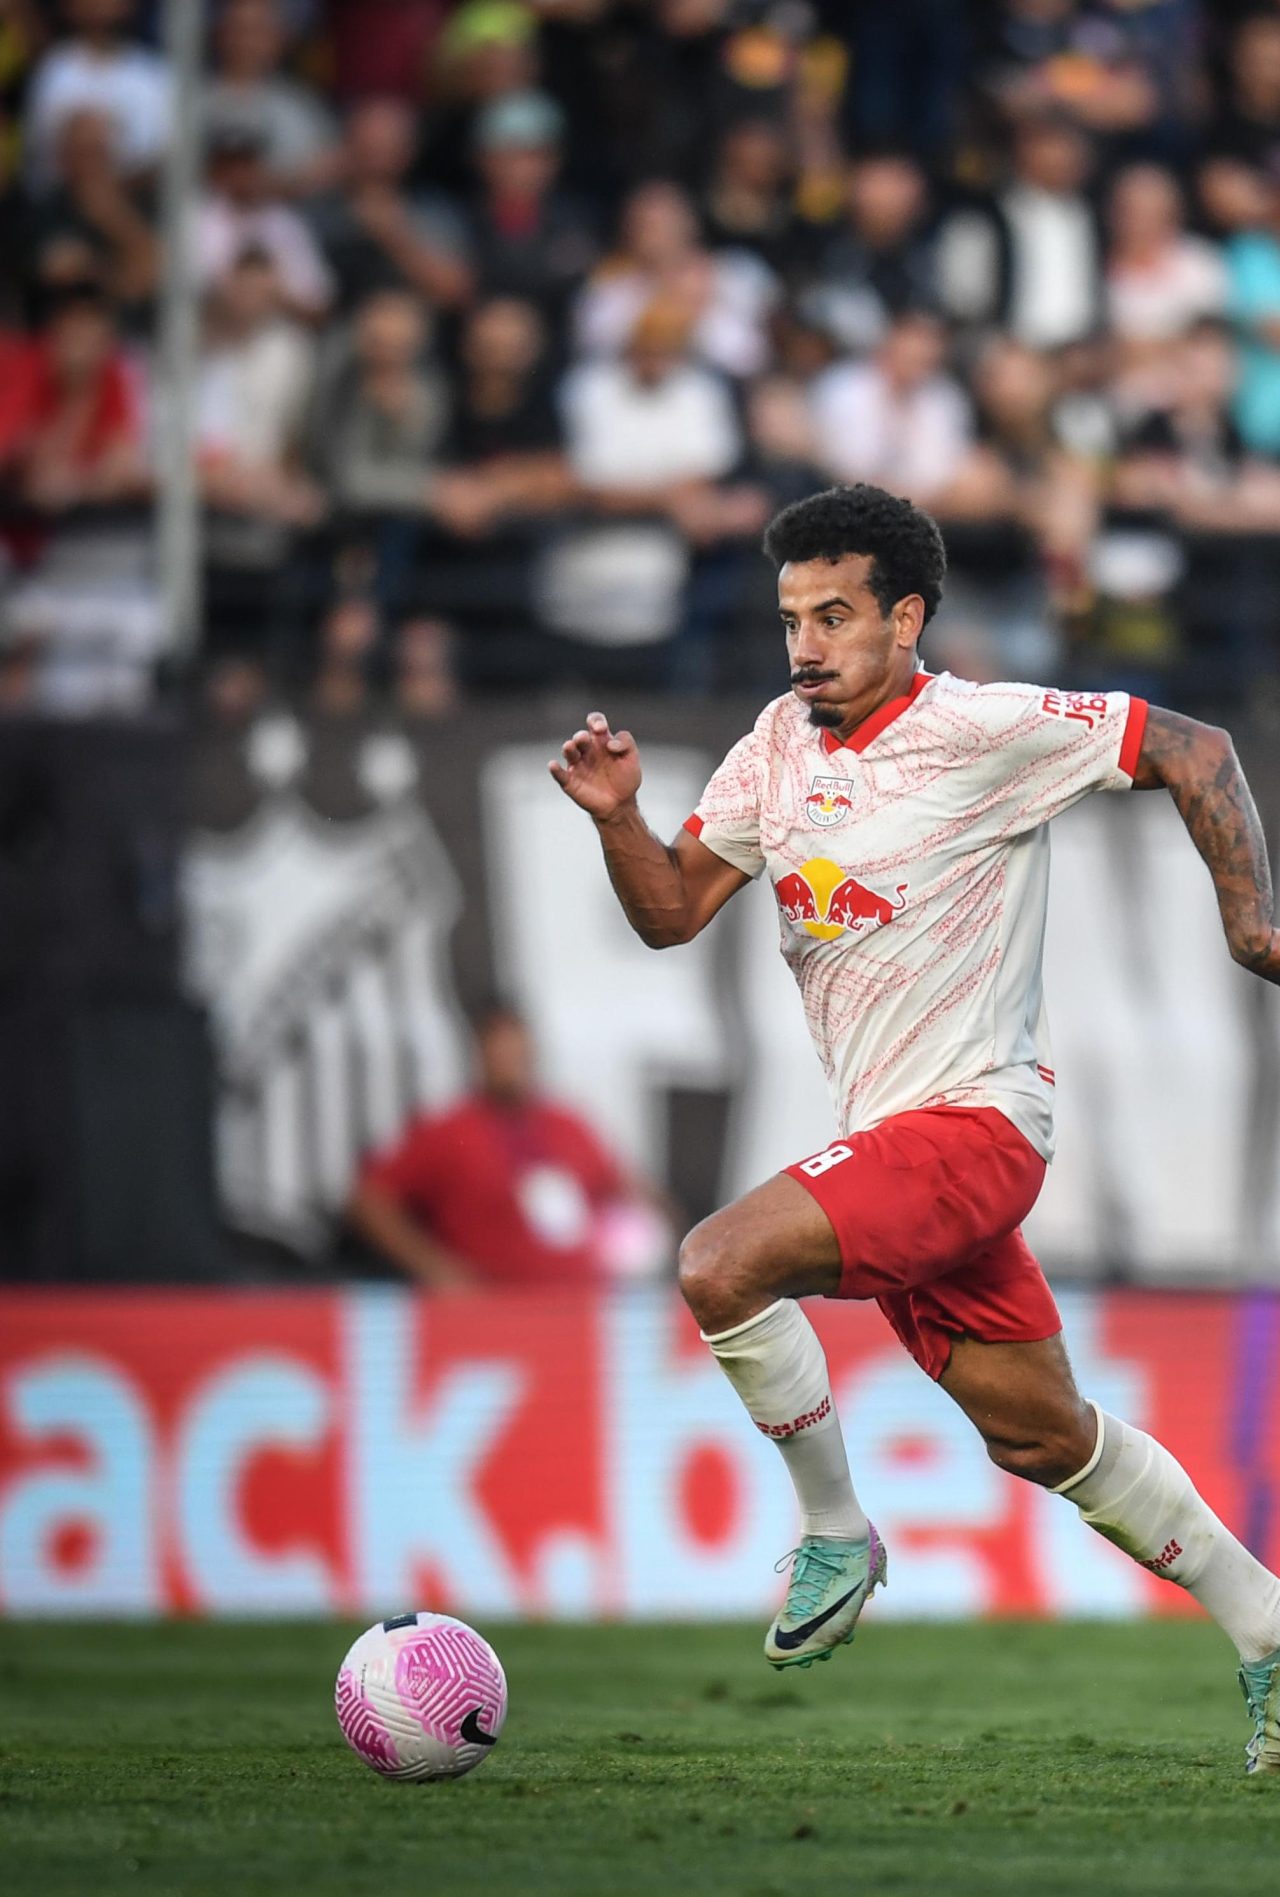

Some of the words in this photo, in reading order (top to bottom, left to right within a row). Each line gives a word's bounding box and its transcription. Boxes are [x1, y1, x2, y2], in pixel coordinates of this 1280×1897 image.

[815, 779, 832, 790] Red
[833, 781, 850, 791] Bull
[799, 1144, 854, 1178] 8
